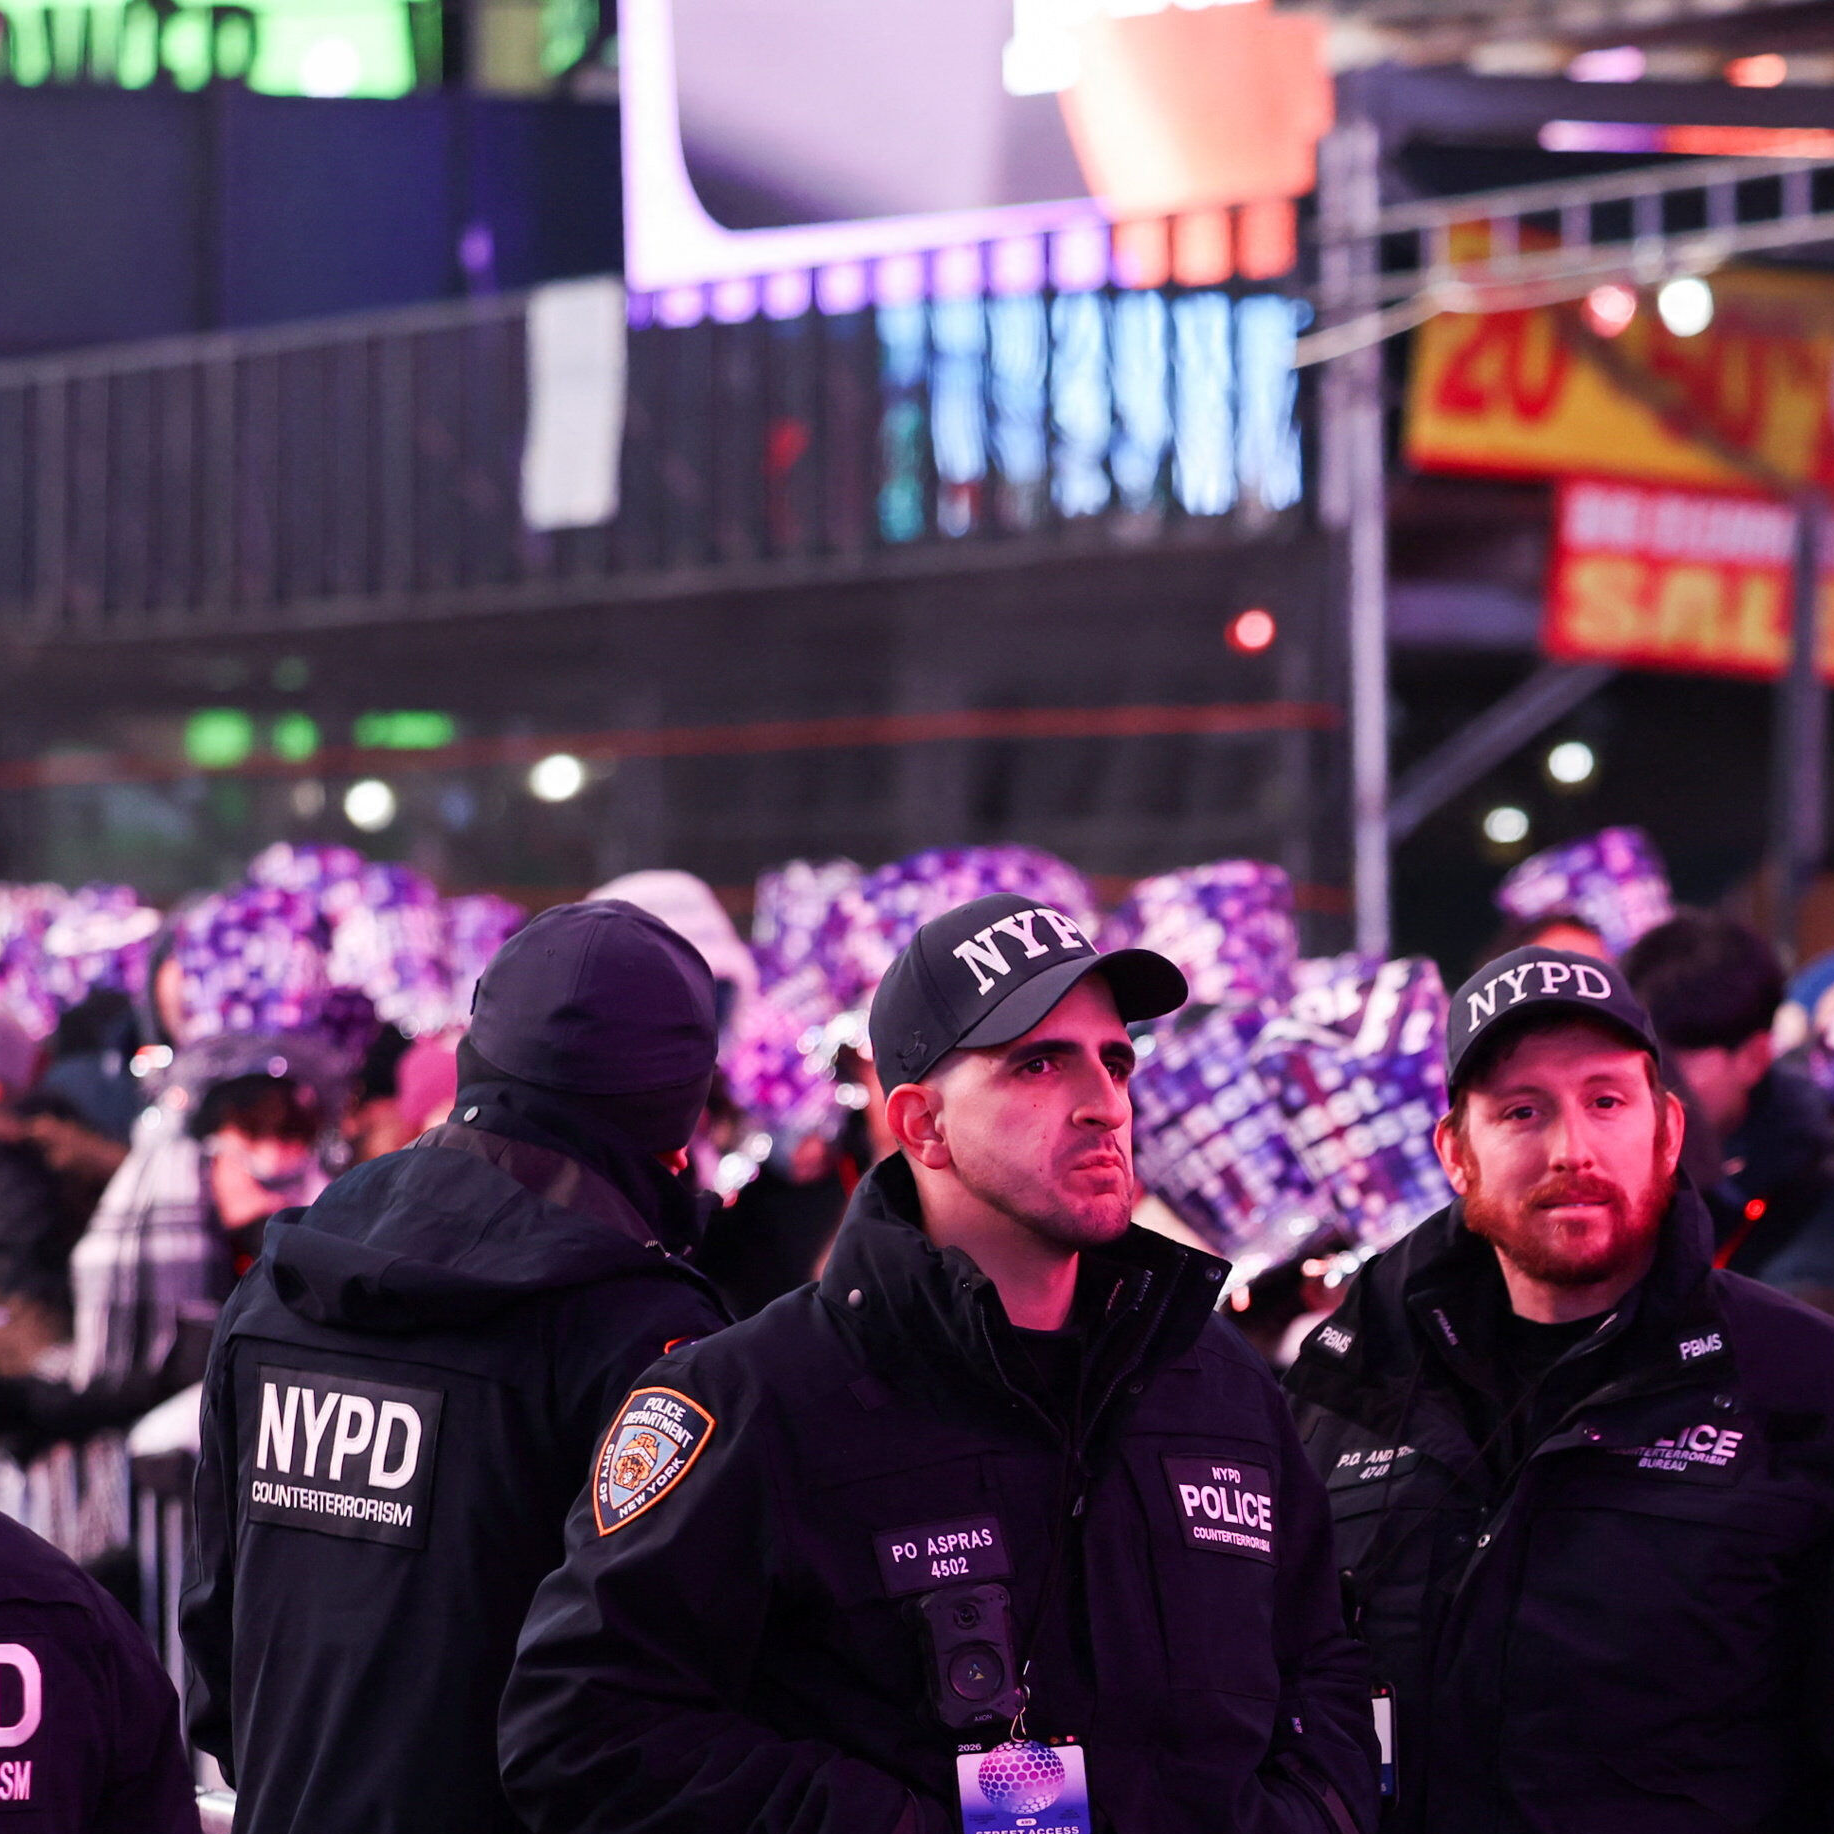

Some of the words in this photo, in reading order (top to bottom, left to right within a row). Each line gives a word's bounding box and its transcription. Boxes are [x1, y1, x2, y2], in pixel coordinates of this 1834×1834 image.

[1467, 961, 1612, 1033] NYPD
[1317, 1325, 1353, 1354] PBMS
[1679, 1333, 1723, 1361] PBMS
[643, 1397, 687, 1422] POLICE
[256, 1382, 422, 1490] NYPD
[622, 1410, 694, 1448] DEPARTMENT
[600, 1443, 616, 1479] CITY
[1211, 1466, 1241, 1484] NYPD
[1638, 1457, 1688, 1473] BUREAU
[598, 1482, 608, 1504] OF
[619, 1492, 647, 1519] NEW
[647, 1457, 686, 1495] YORK
[252, 1480, 414, 1528] COUNTERTERRORISM
[1179, 1484, 1272, 1532] POLICE
[891, 1542, 918, 1563] PO
[927, 1528, 993, 1556] ASPRAS
[1193, 1526, 1271, 1553] COUNTERTERRORISM
[931, 1557, 969, 1579] 4502
[957, 1743, 982, 1752] 2026
